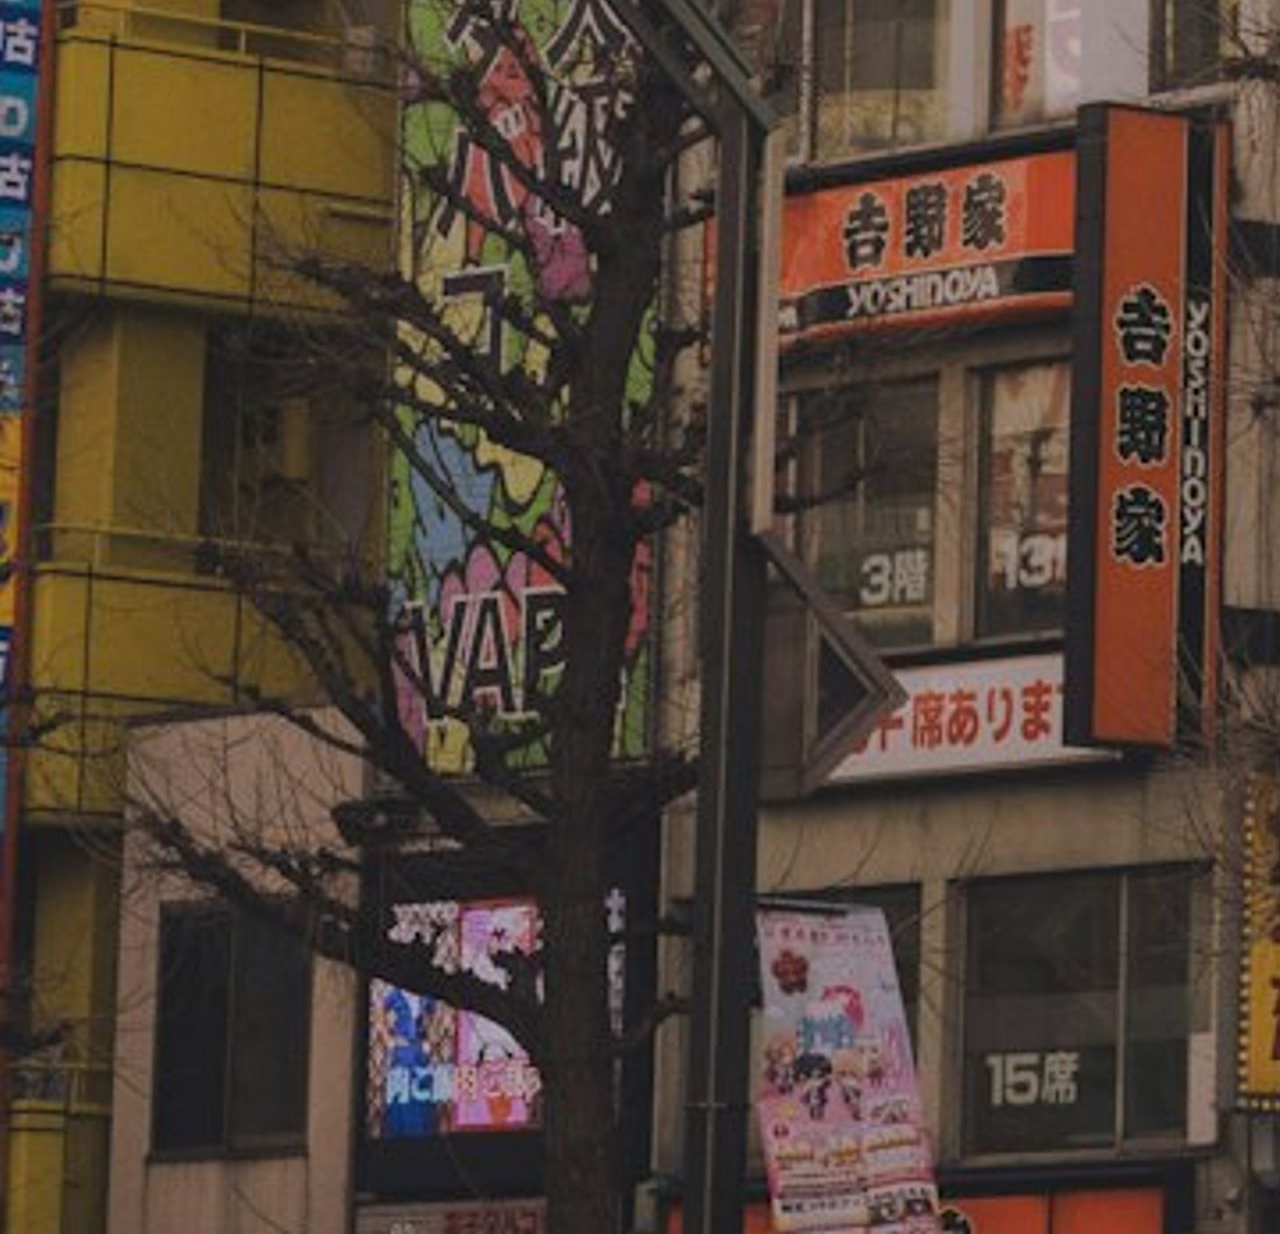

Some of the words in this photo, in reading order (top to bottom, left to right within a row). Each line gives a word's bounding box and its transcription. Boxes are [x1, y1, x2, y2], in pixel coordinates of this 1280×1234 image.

[842, 172, 1008, 272] 吉野家
[845, 263, 1000, 318] YOSHINOYA
[1113, 282, 1175, 567] 吉野家
[1180, 300, 1212, 566] YOSHINOYA
[859, 548, 931, 606] 3階
[853, 678, 1064, 754] 席ありま
[986, 1050, 1080, 1107] 15席
